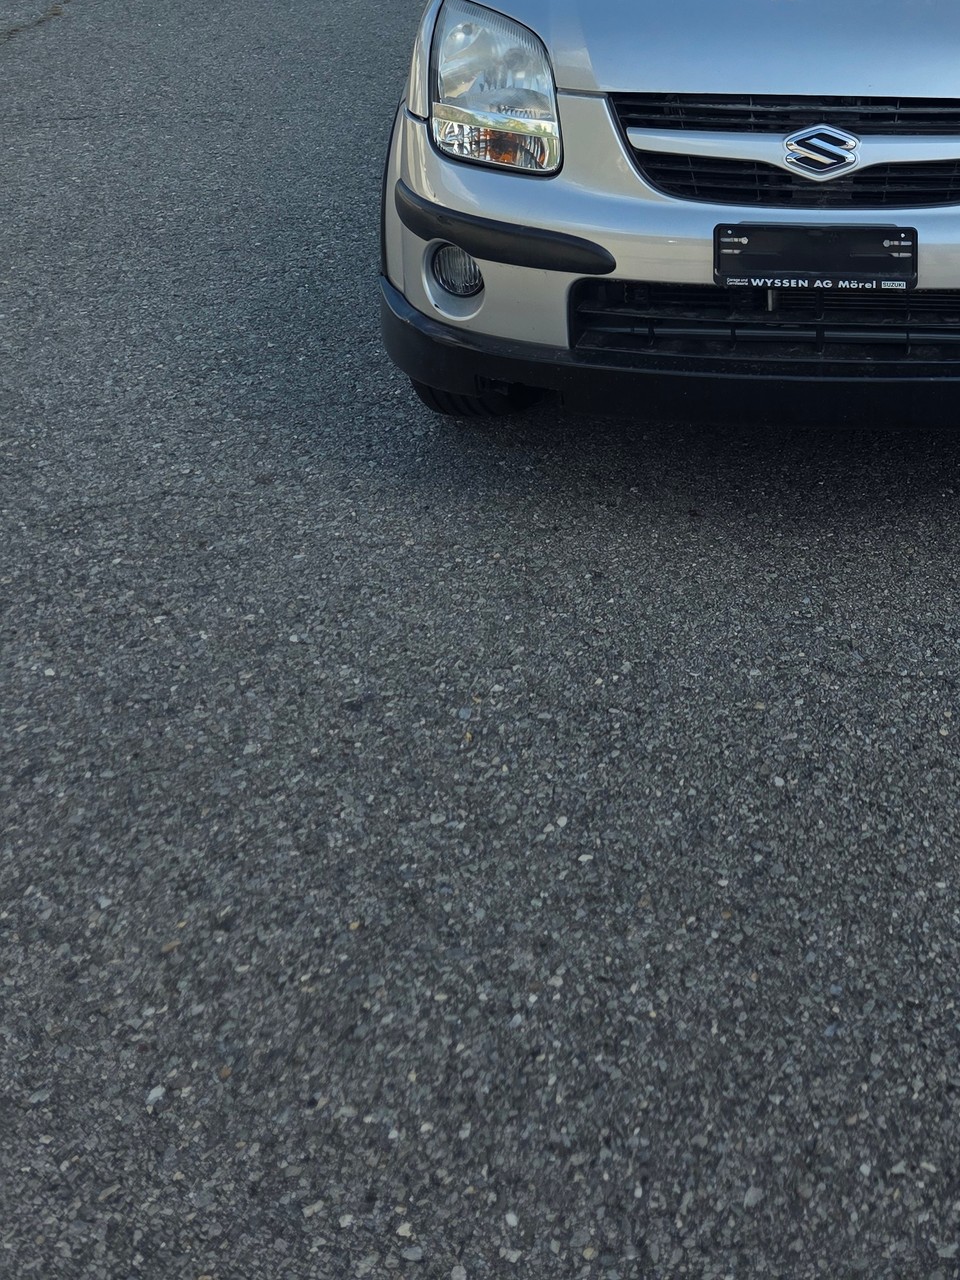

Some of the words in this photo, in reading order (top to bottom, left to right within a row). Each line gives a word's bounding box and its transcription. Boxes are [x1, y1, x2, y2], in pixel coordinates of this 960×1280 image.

[751, 278, 808, 288] WYSSEN
[814, 279, 833, 288] AG
[838, 279, 876, 289] Mörel
